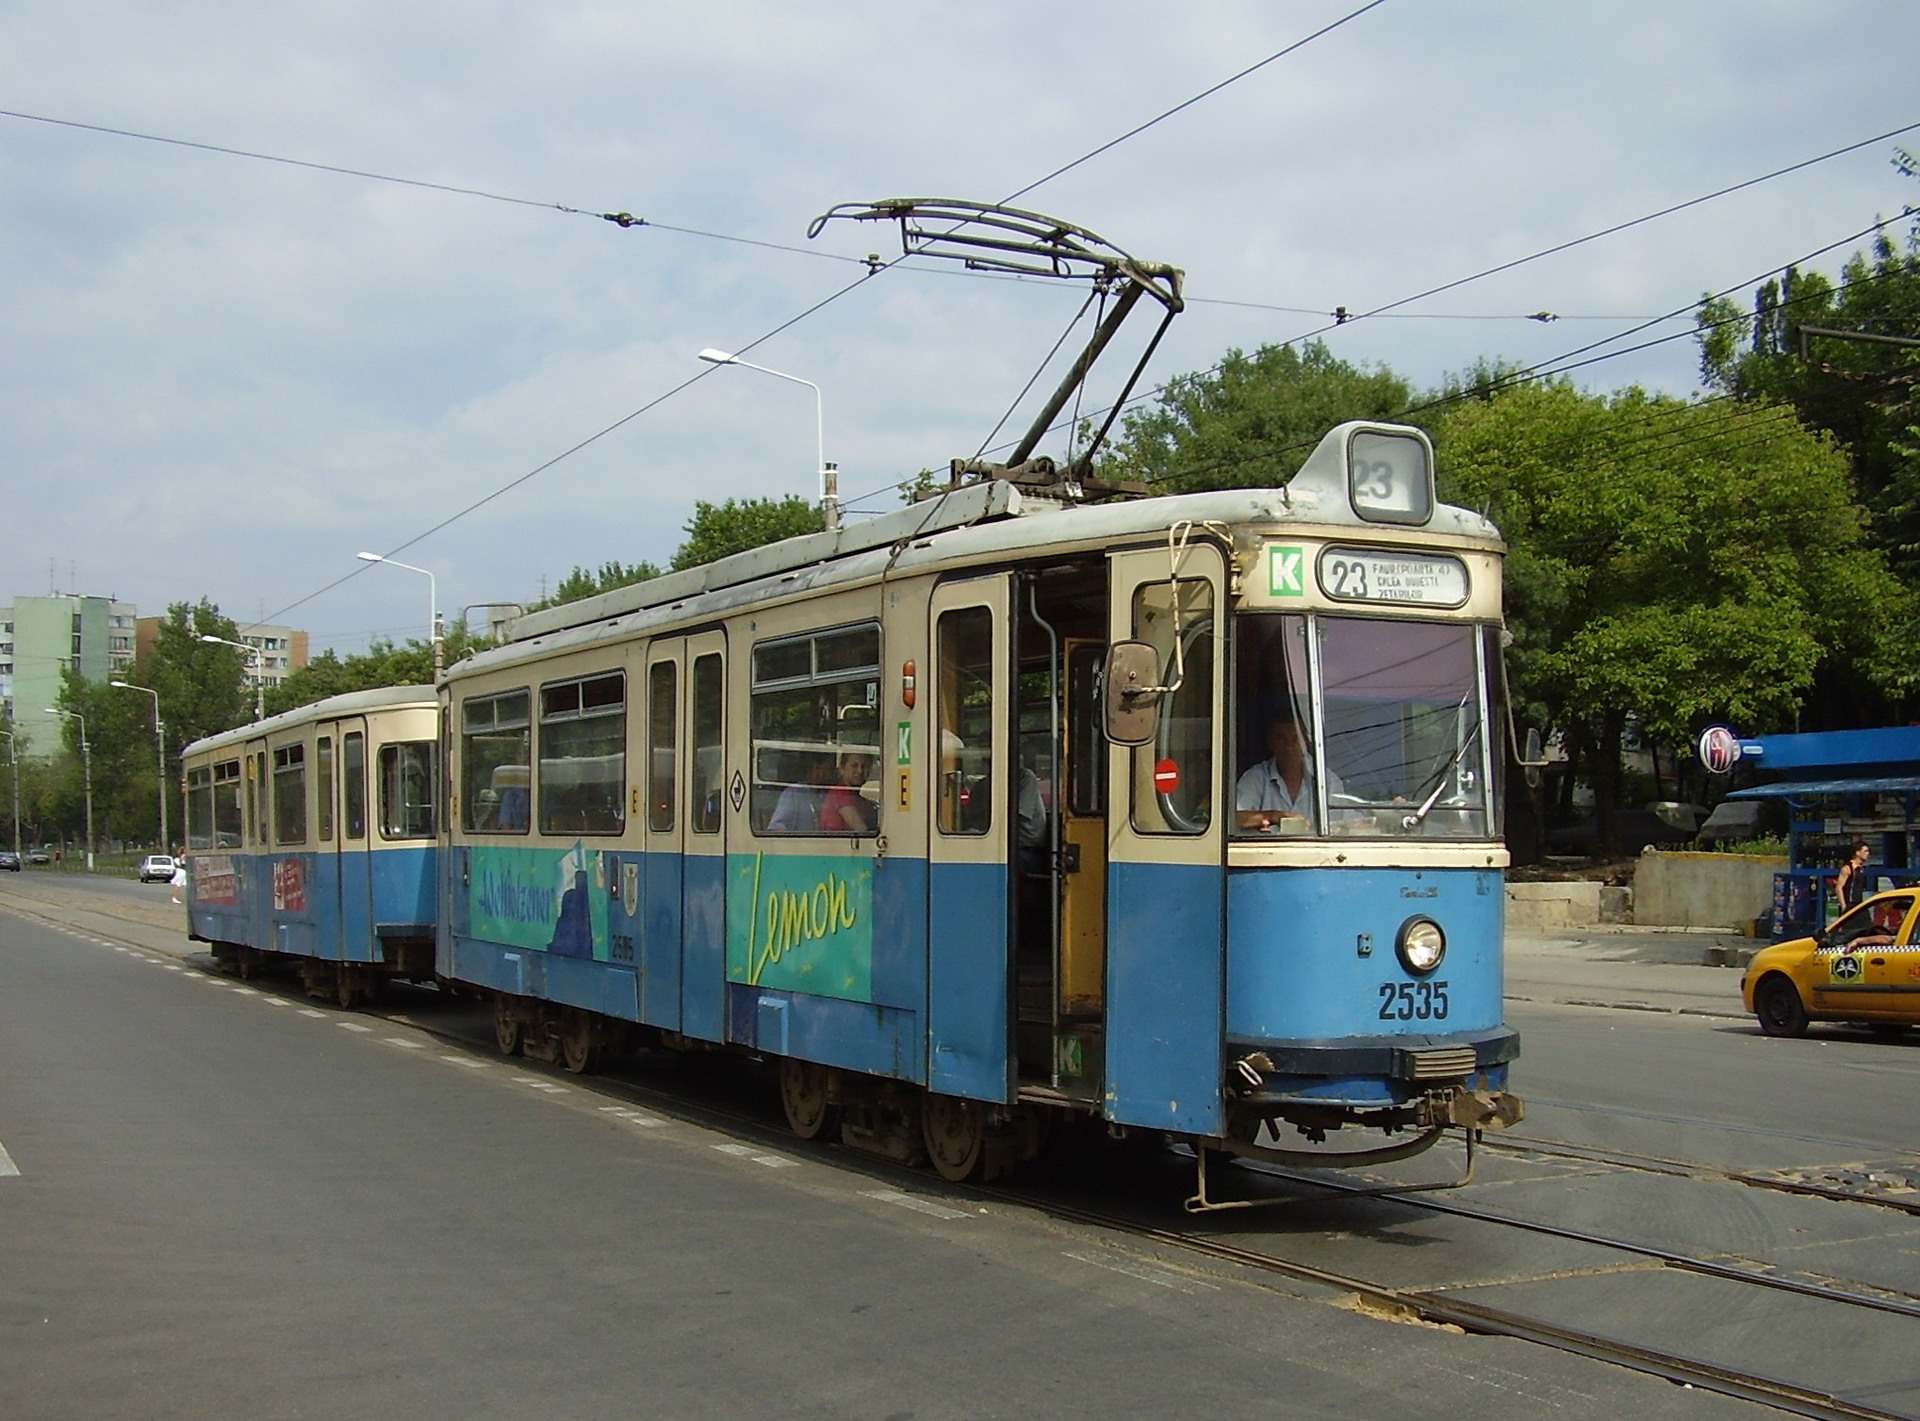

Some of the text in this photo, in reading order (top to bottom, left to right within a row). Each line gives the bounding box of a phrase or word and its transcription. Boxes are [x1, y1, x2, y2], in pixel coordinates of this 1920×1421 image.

[1354, 459, 1393, 499] 23
[1273, 552, 1301, 591] K
[1332, 561, 1368, 597] 23
[898, 728, 910, 759] K
[900, 775, 908, 806] E
[747, 849, 856, 986] Lemon
[1379, 981, 1448, 1020] 2535
[1060, 1039, 1077, 1073] K
